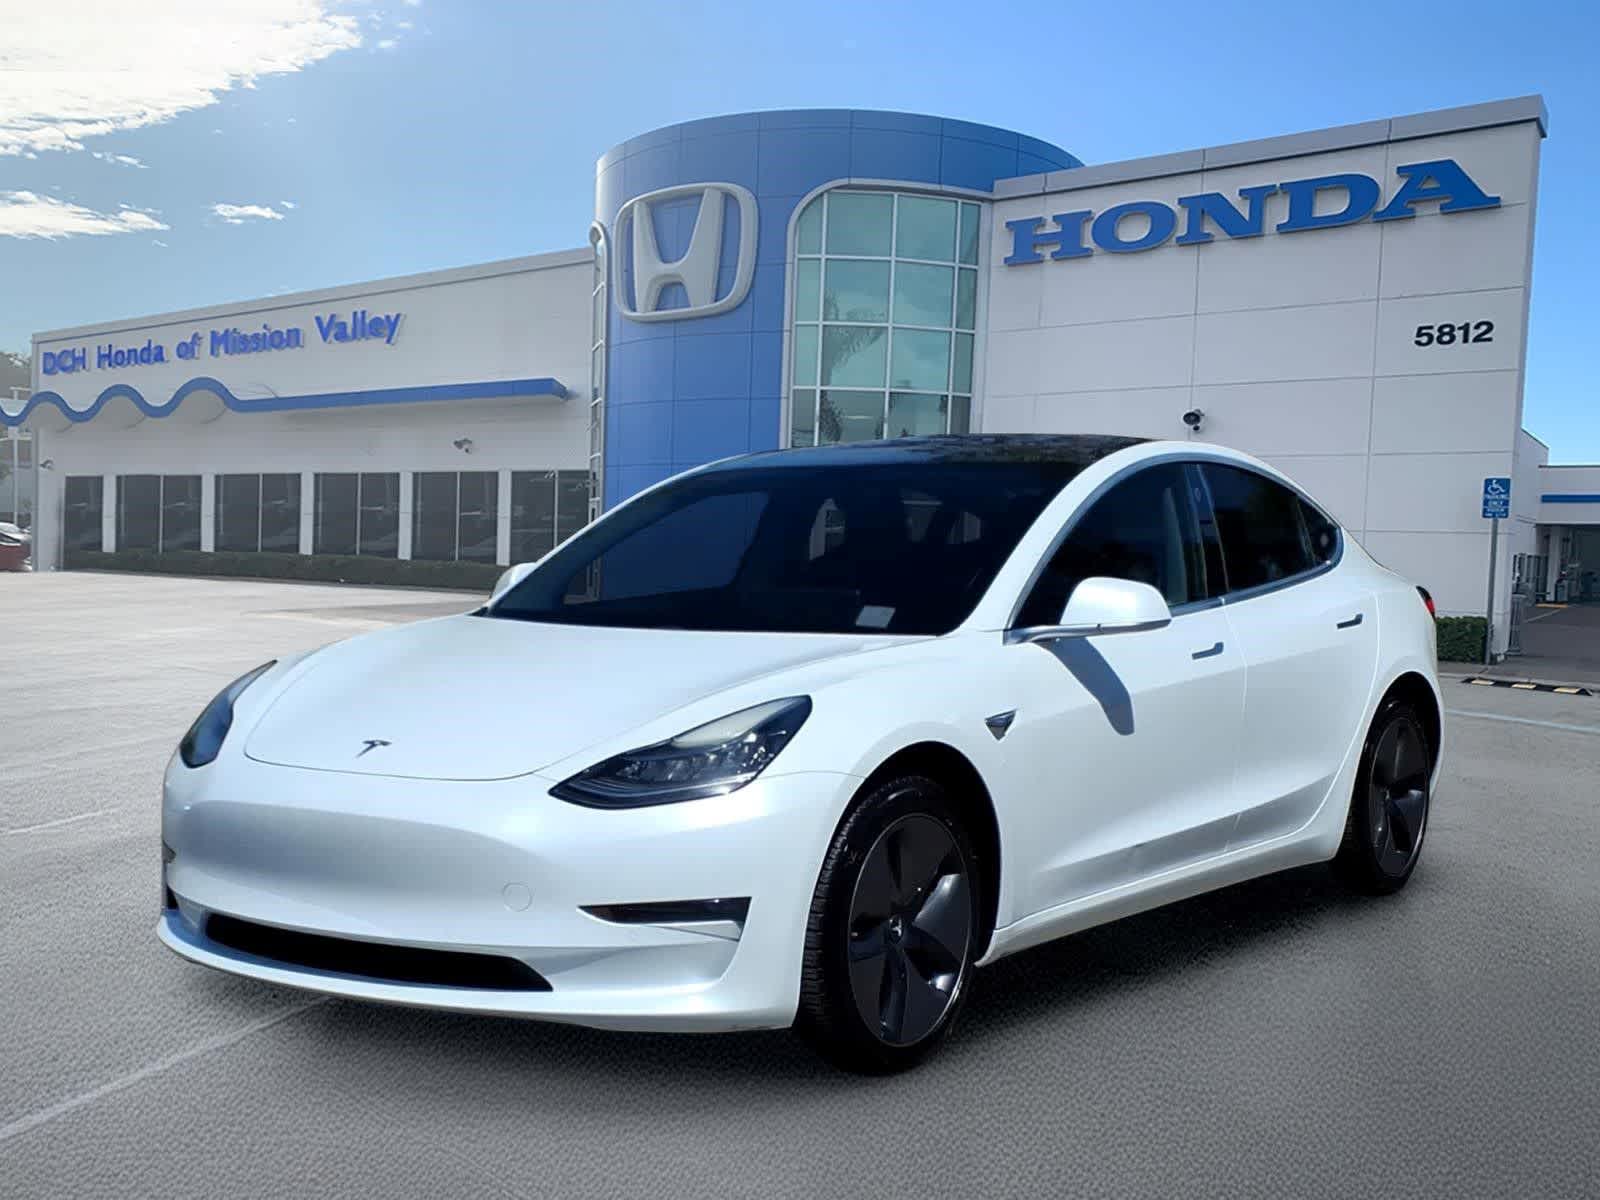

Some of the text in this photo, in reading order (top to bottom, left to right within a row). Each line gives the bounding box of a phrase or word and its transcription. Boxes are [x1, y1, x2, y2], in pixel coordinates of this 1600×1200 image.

[1003, 157, 1501, 266] HONDA
[42, 310, 402, 375] DCH Honda of Mission Valley
[1413, 320, 1494, 347] 5812
